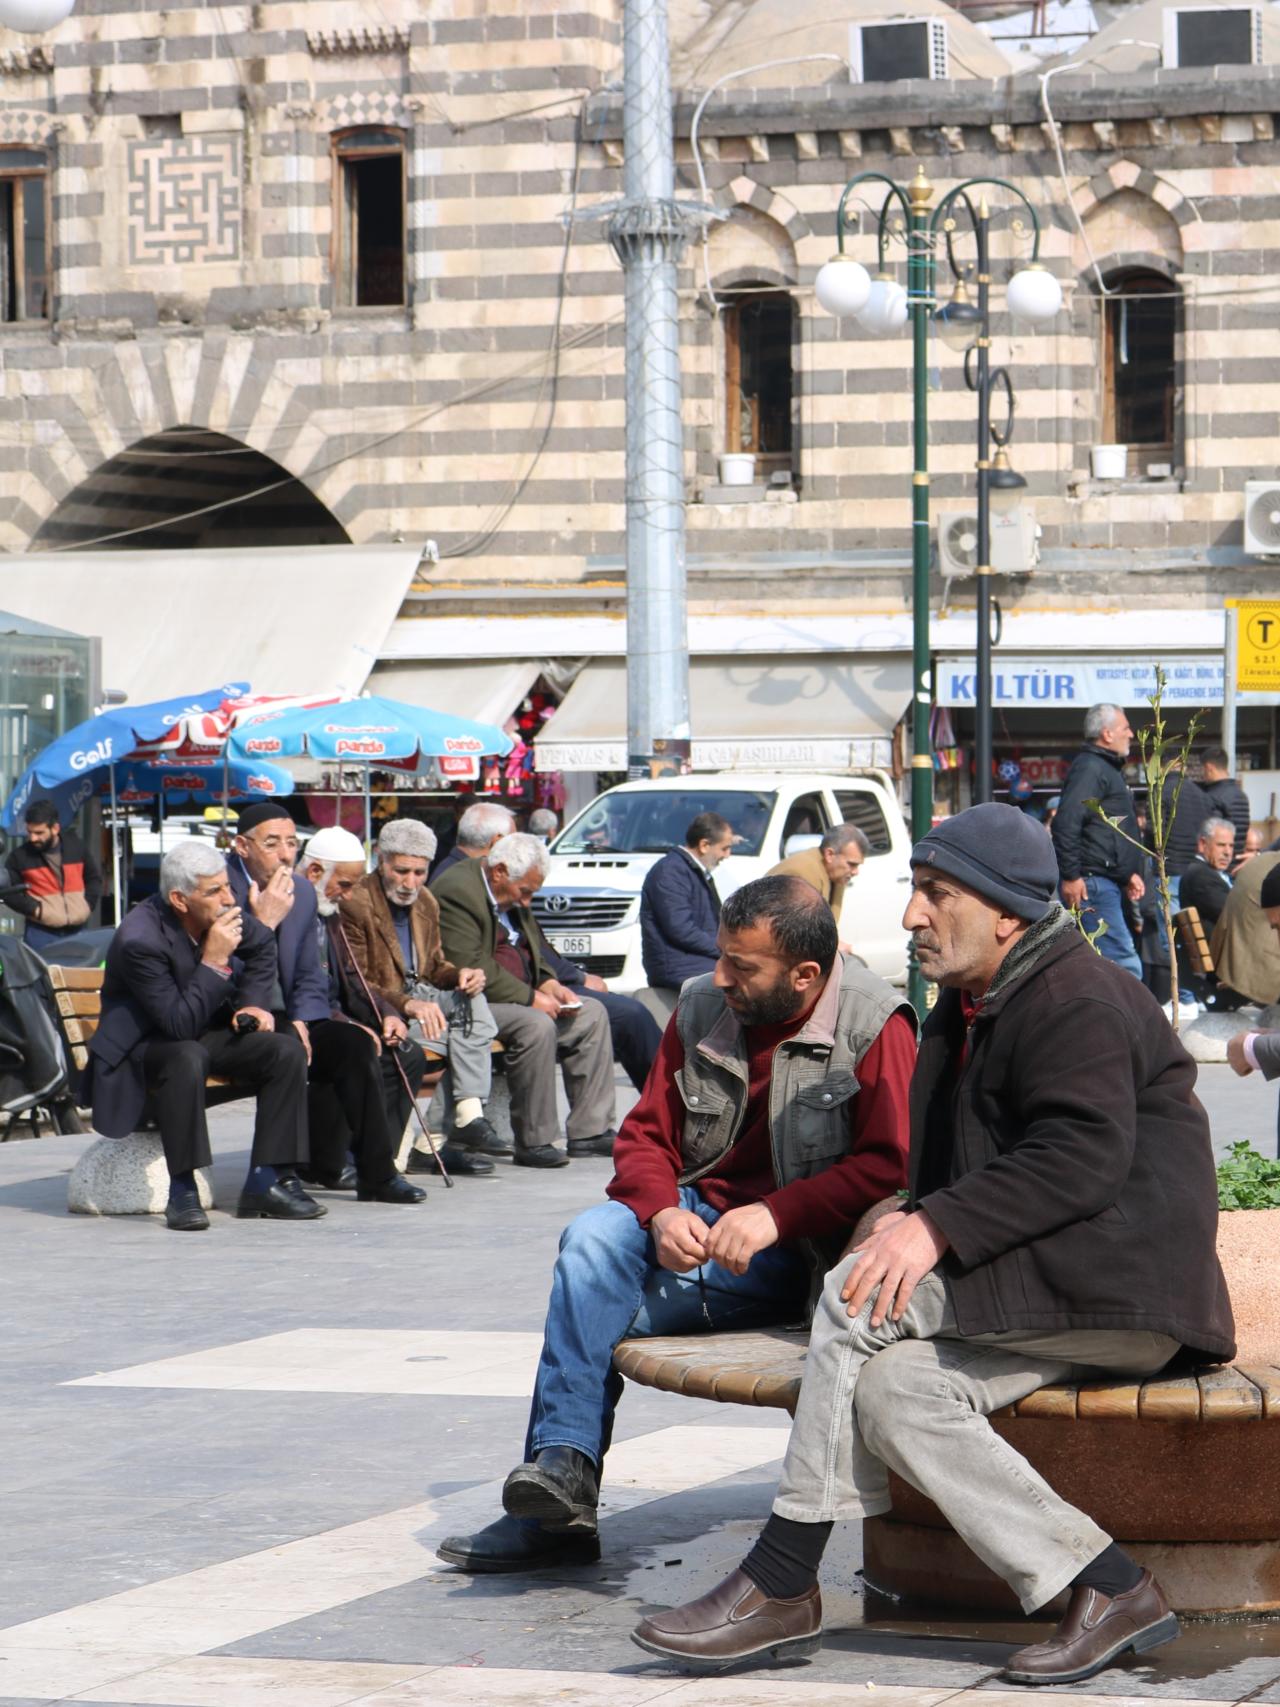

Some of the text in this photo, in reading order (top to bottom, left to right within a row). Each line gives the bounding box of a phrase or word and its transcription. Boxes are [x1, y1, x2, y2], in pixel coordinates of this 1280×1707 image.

[1257, 620, 1274, 643] T
[951, 669, 1075, 700] KLTÜR
[70, 738, 113, 770] Golf
[336, 739, 385, 754] panda
[445, 738, 483, 752] panda
[563, 938, 585, 952] 066
